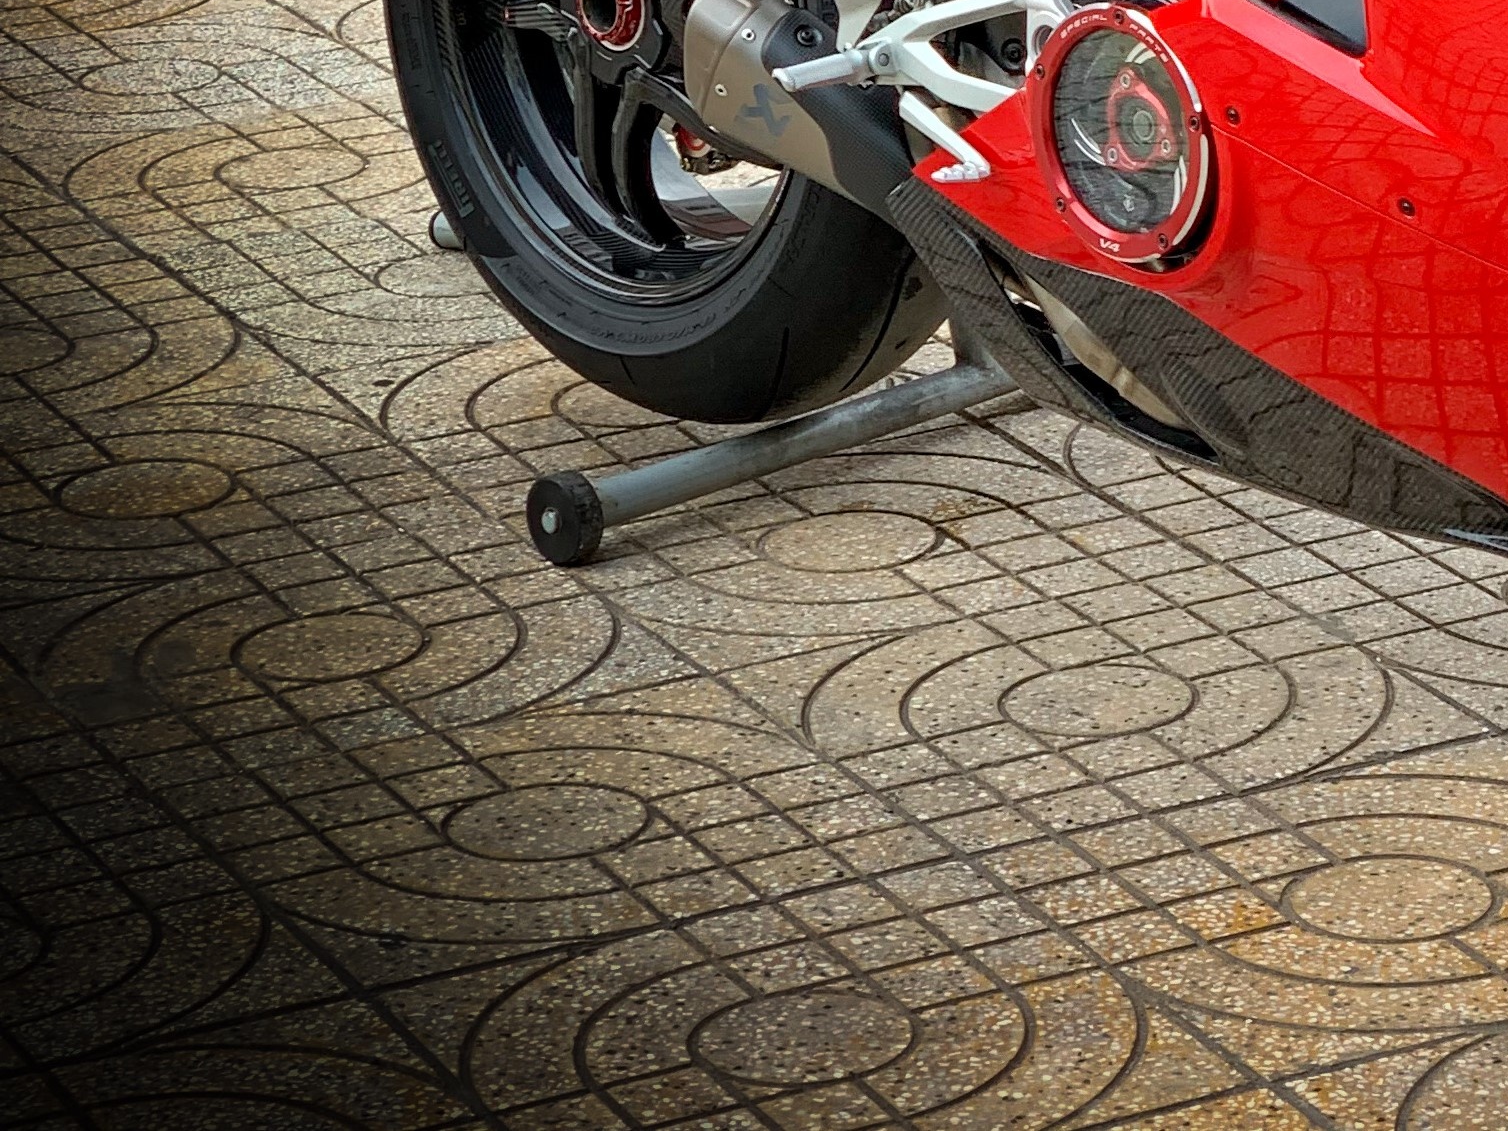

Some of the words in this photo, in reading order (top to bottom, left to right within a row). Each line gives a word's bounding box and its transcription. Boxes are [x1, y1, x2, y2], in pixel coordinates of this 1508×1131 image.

[1060, 14, 1108, 39] SPECIAL
[1129, 23, 1169, 63] PARTS
[1099, 238, 1121, 253] V4
